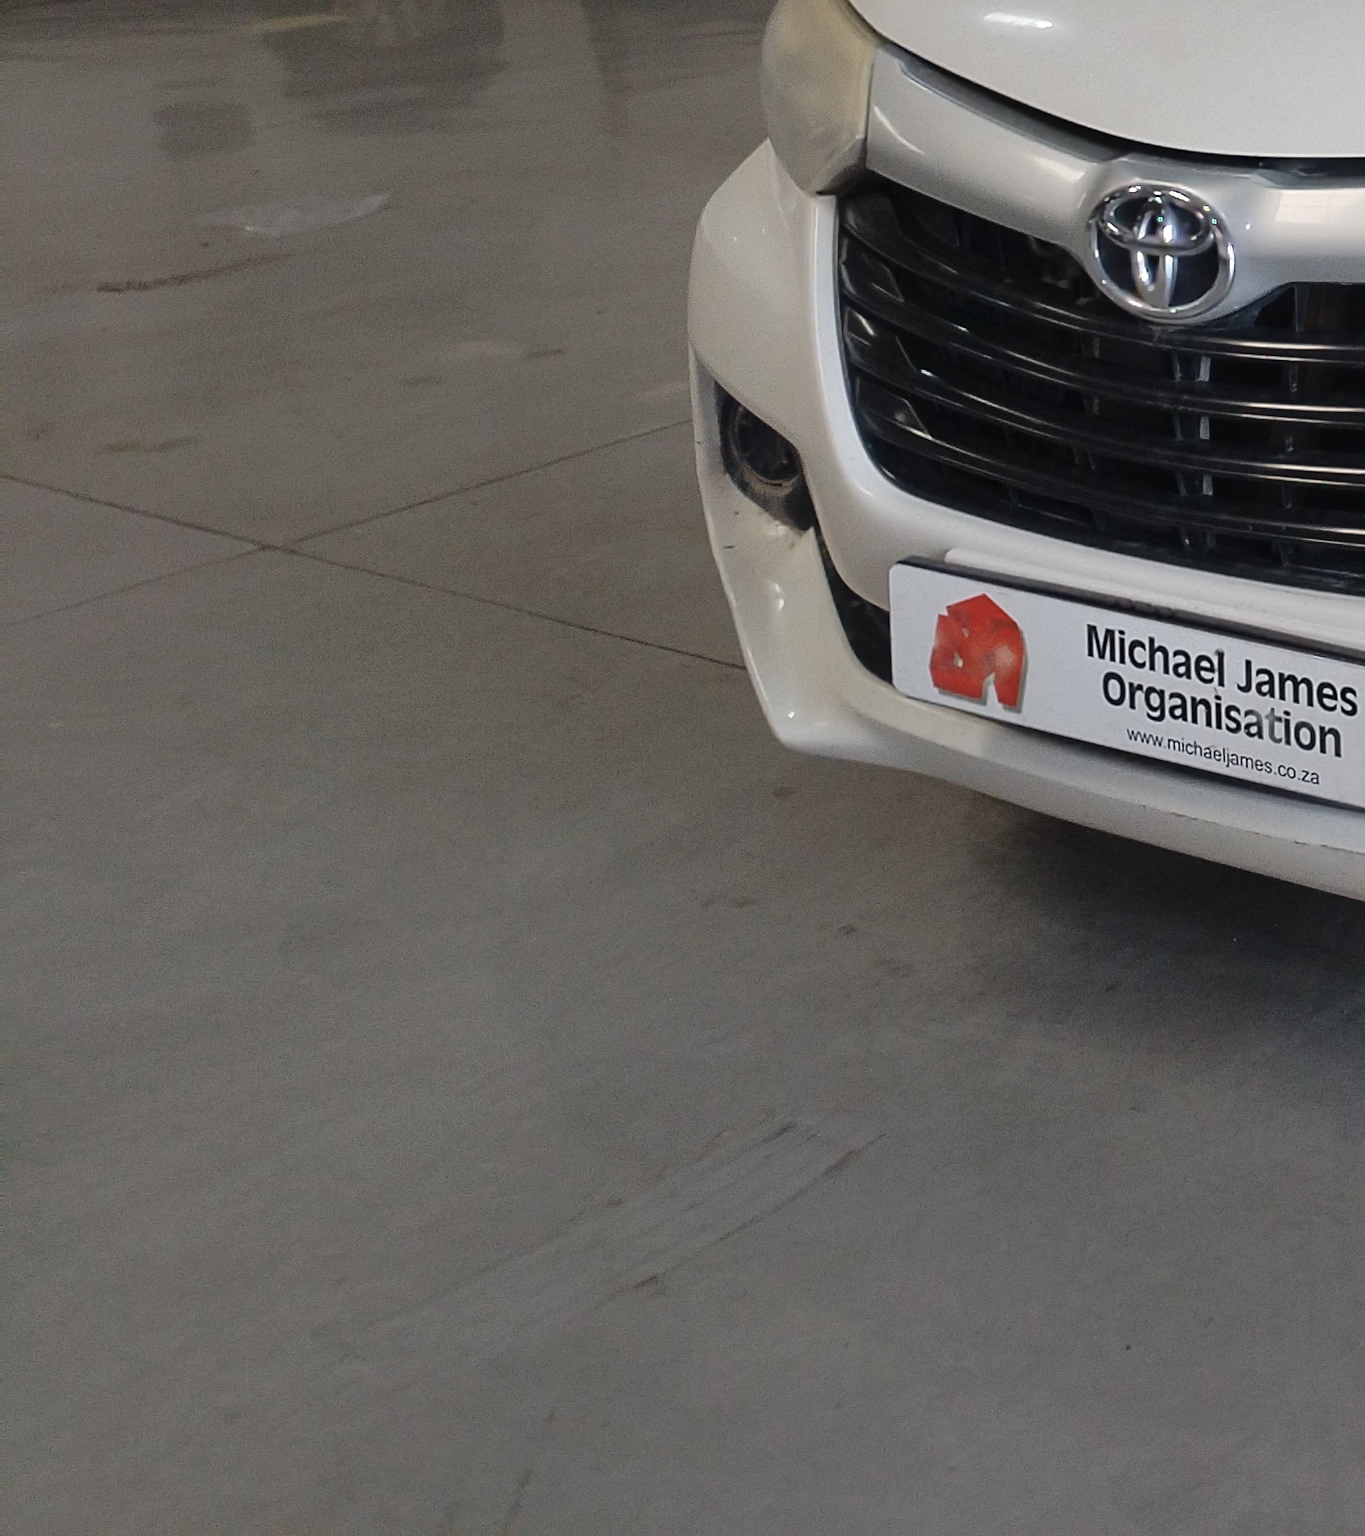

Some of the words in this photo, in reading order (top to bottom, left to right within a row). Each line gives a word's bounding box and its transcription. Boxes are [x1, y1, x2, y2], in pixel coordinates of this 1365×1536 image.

[1086, 623, 1226, 688] Michael
[1236, 659, 1359, 717] James
[1102, 671, 1343, 758] Organisation
[1126, 725, 1321, 786] www.michaeljames.co.za
